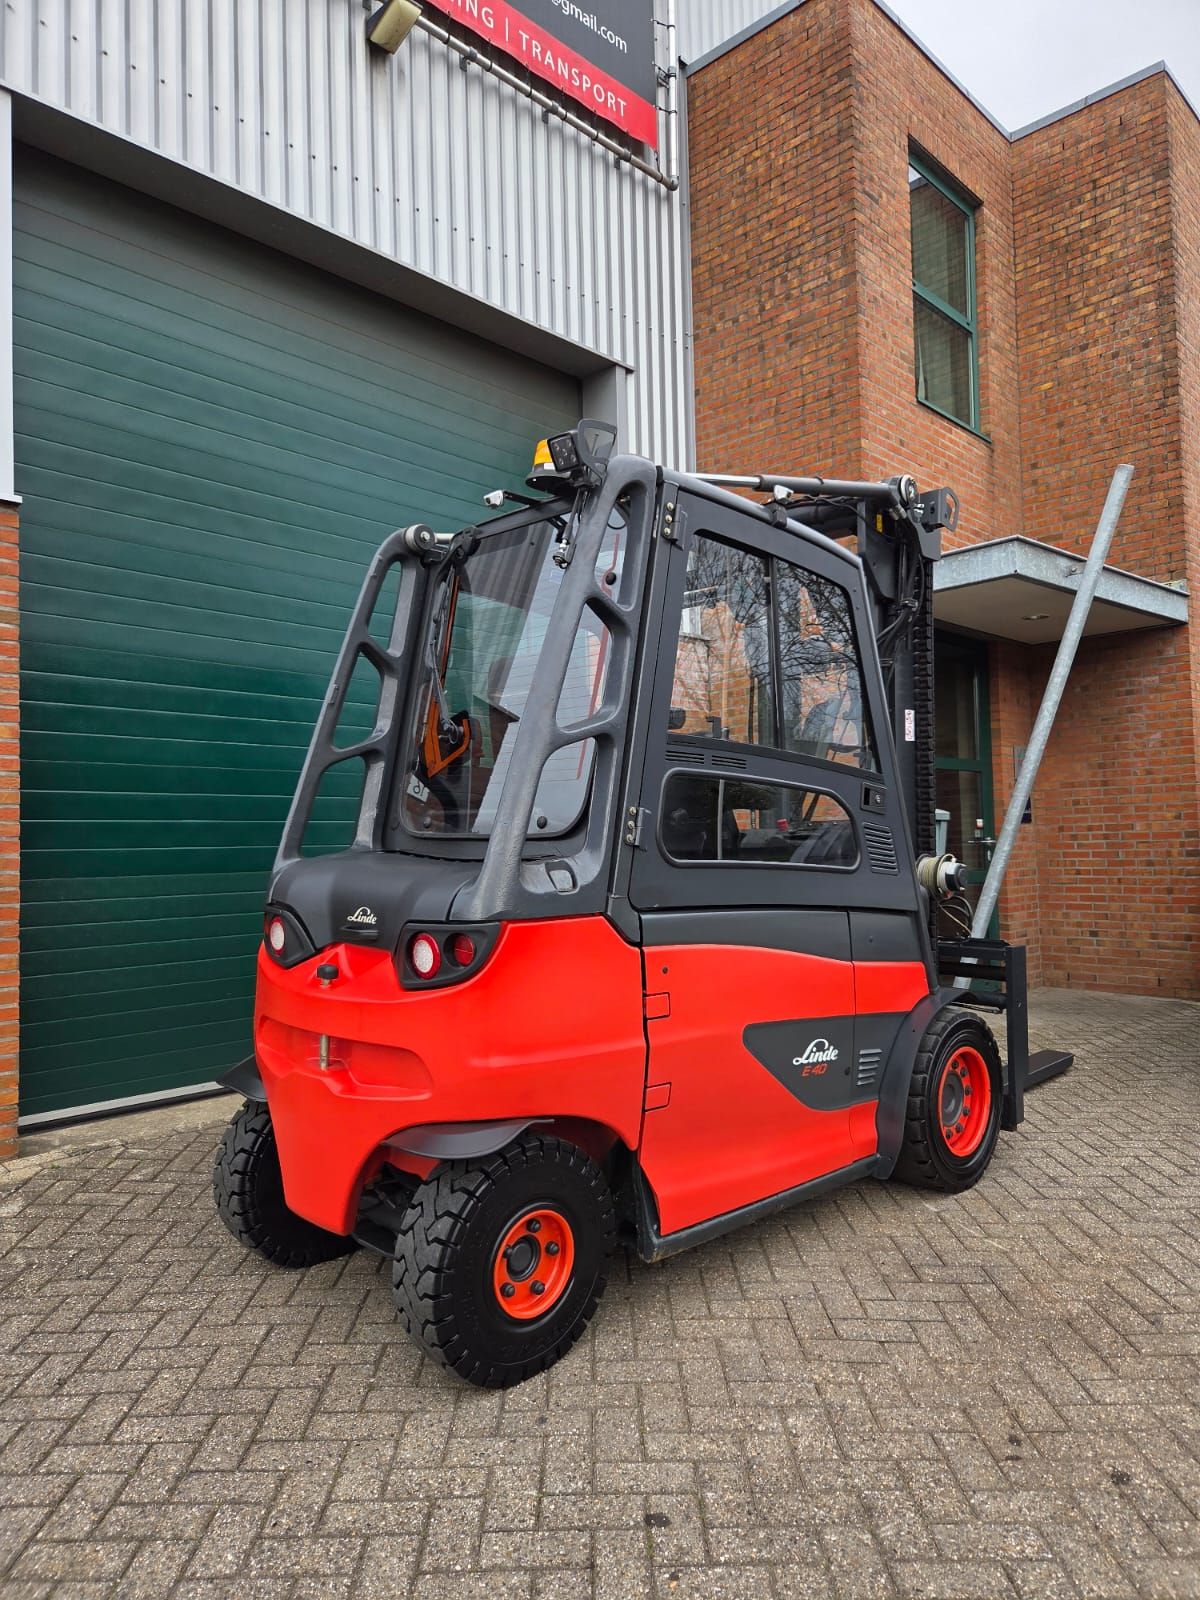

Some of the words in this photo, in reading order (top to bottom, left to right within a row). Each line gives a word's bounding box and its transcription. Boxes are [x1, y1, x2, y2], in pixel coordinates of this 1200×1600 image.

[518, 30, 628, 118] TRANSPORT
[346, 906, 378, 925] Linde
[792, 1038, 840, 1066] Linde
